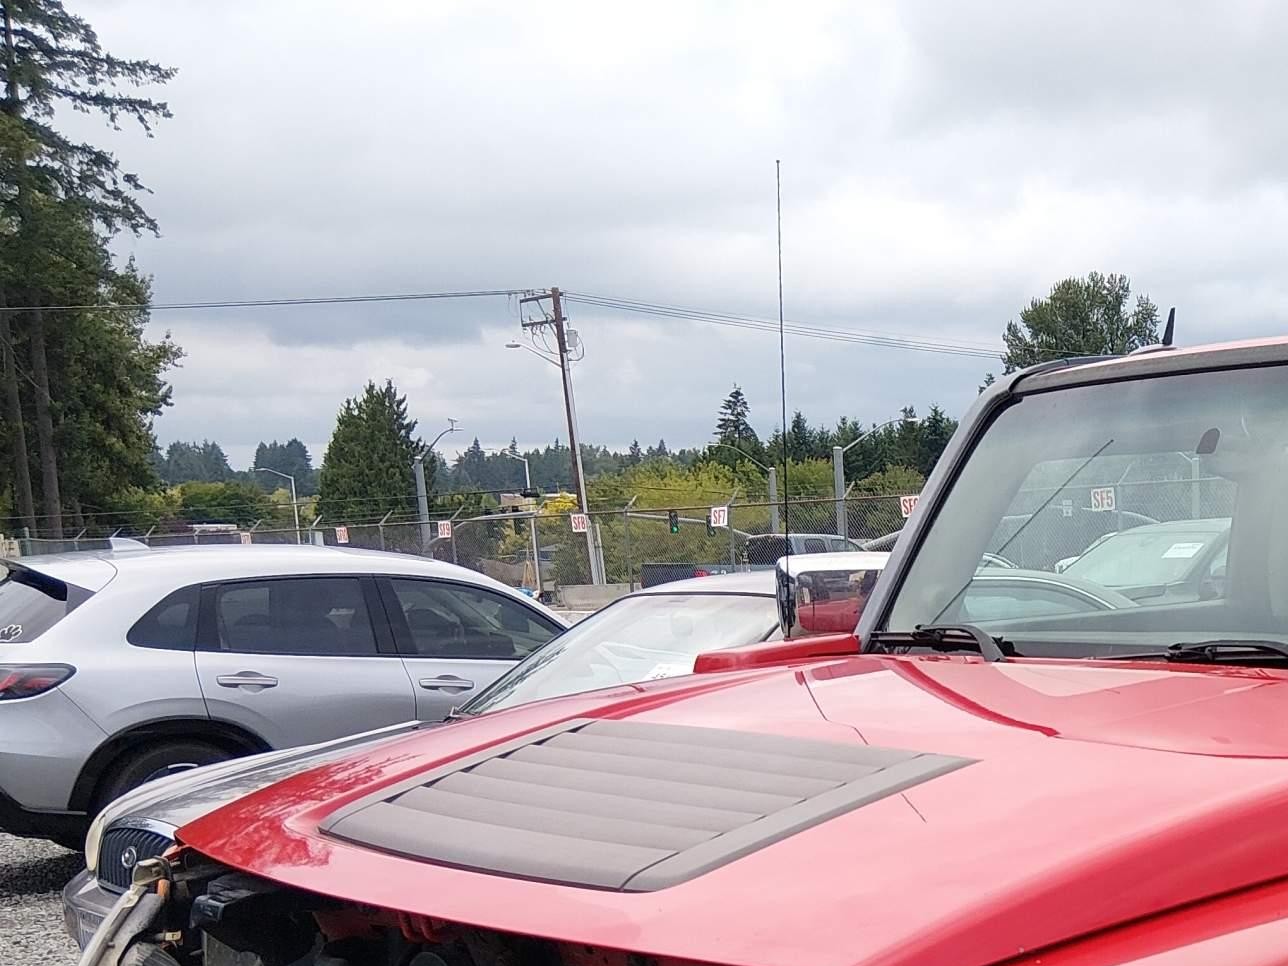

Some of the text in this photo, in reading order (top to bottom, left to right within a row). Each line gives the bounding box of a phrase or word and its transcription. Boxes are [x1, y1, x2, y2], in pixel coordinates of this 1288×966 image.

[1092, 489, 1114, 510] SF5
[572, 515, 586, 531] SF8
[713, 509, 727, 525] SF7
